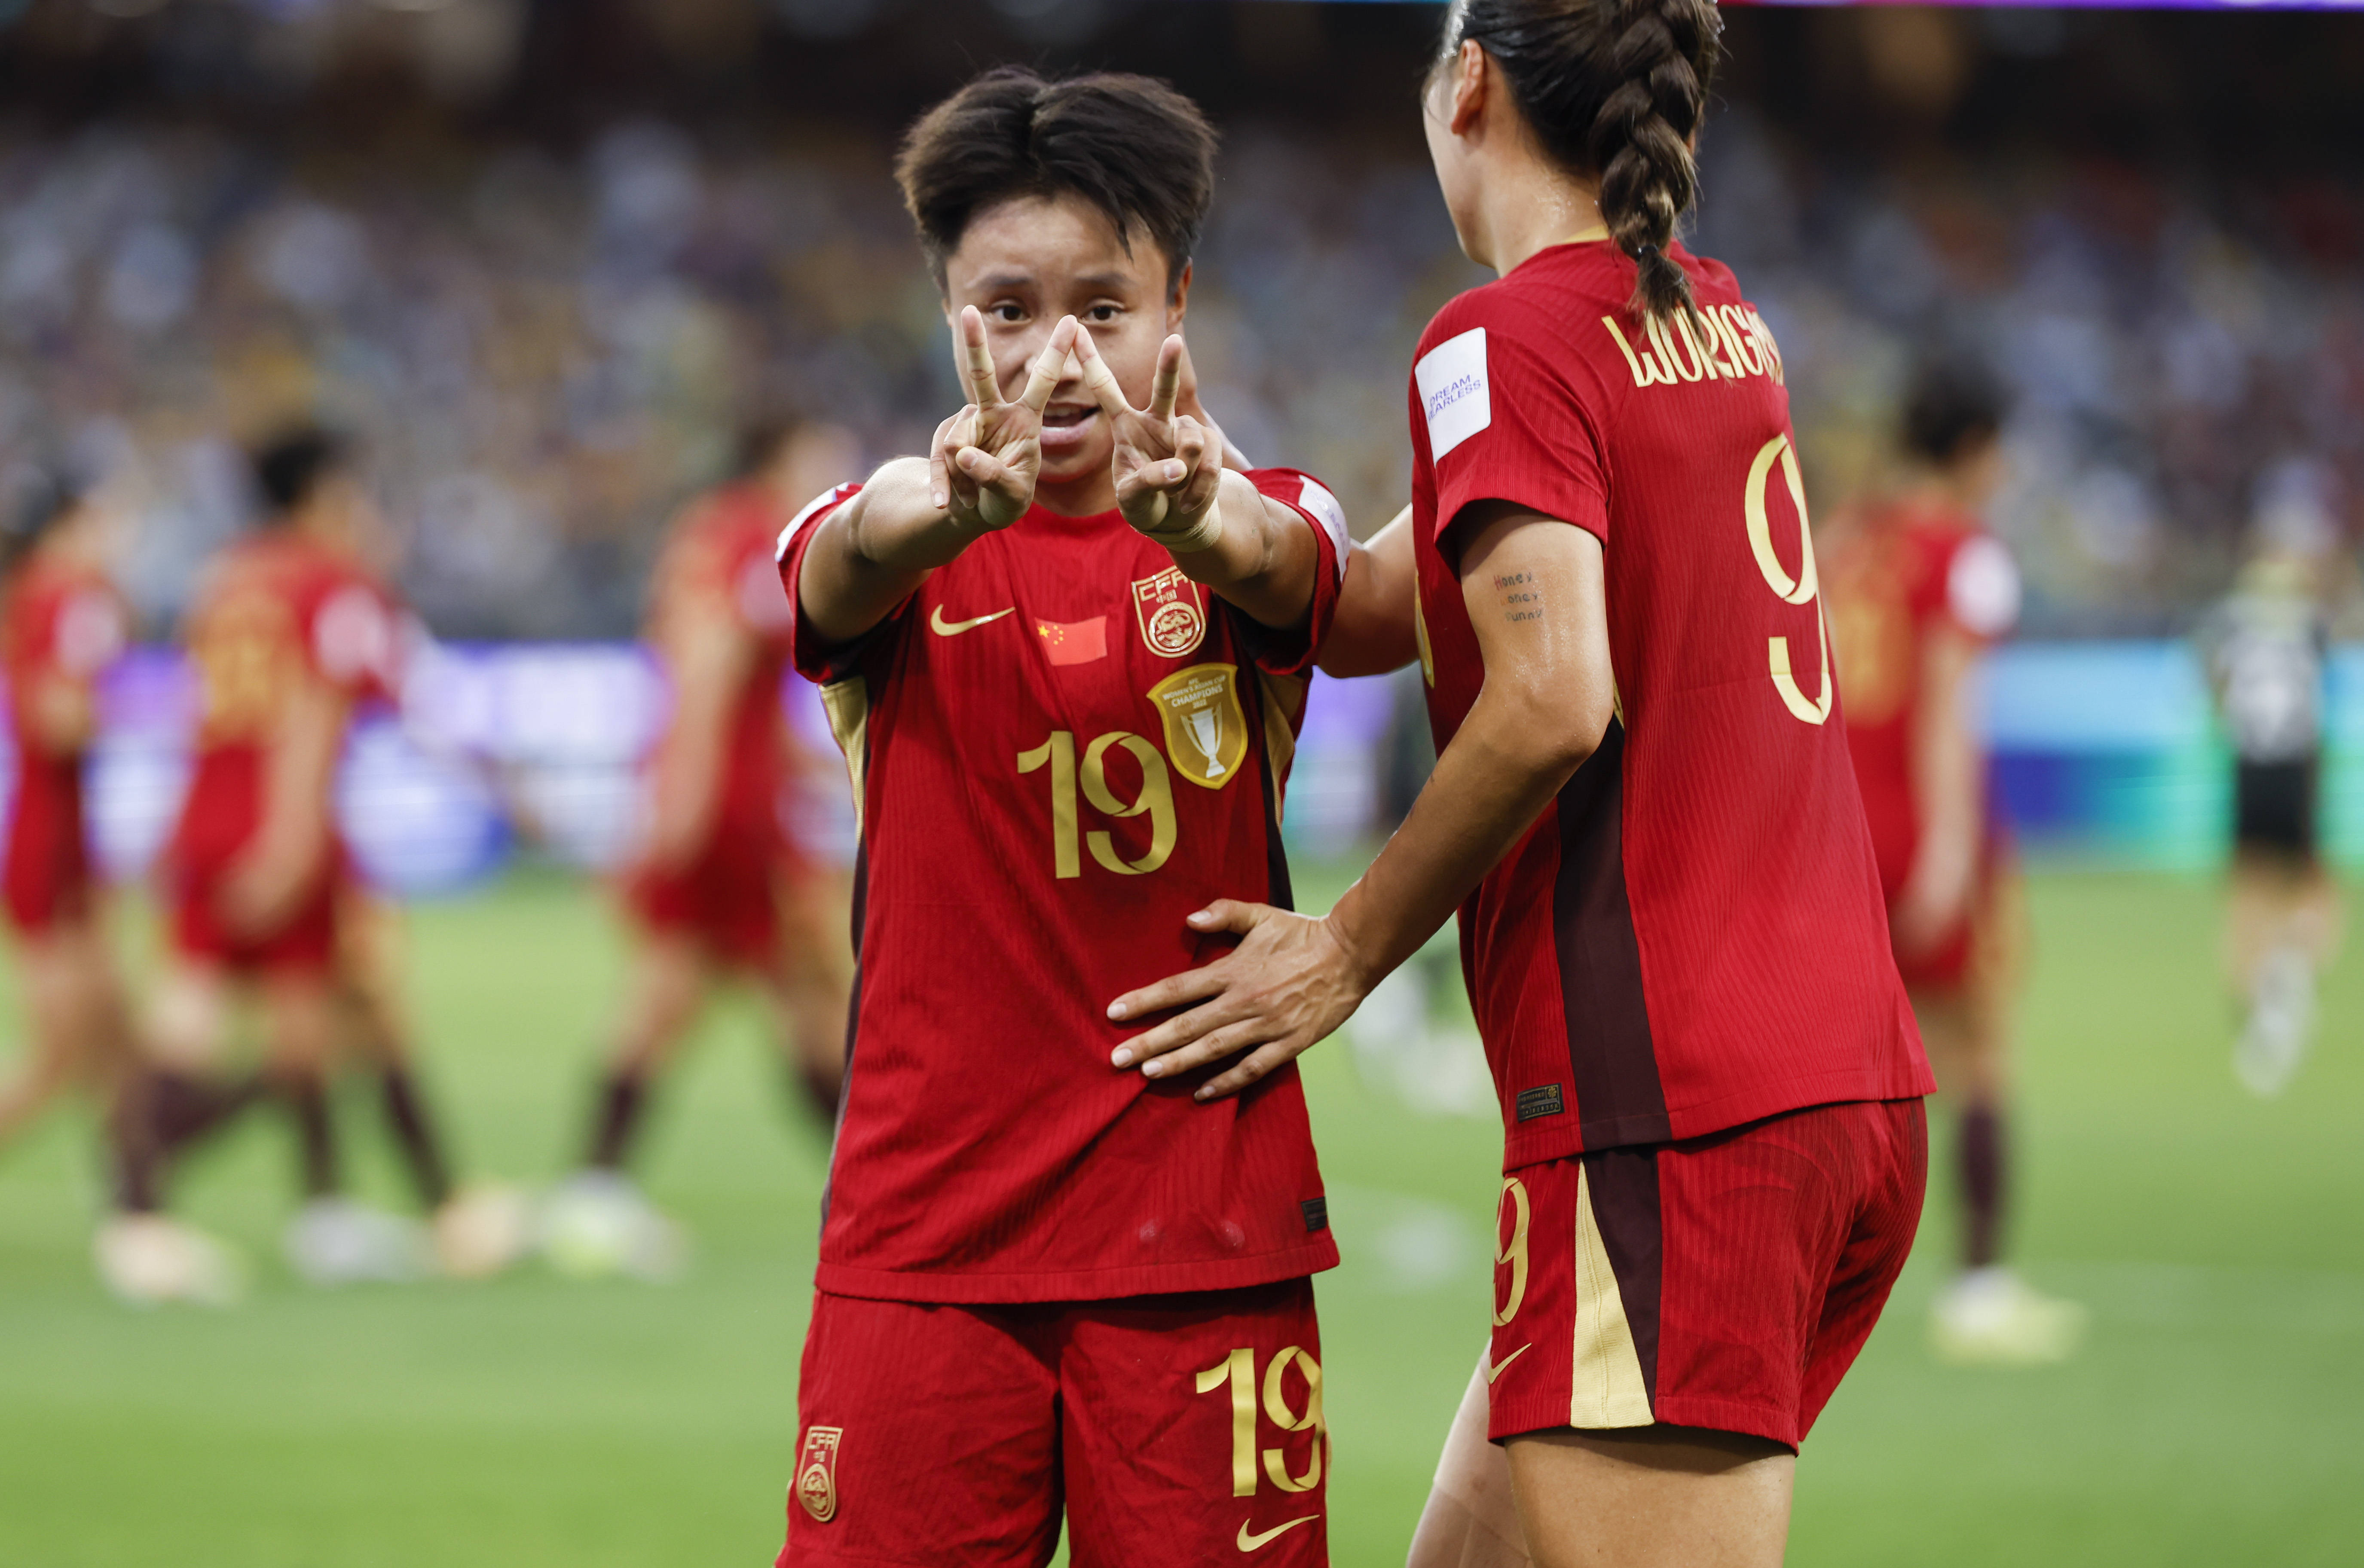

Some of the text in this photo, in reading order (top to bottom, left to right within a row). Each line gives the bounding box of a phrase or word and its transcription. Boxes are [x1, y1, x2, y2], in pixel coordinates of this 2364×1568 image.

[1430, 374, 1470, 408] DREAM
[1139, 569, 1188, 602] CFA
[1494, 572, 1532, 591] Honey
[1745, 432, 1832, 725] 9
[1171, 684, 1223, 707] CHAMPIONS
[1017, 731, 1177, 879] 19
[1493, 1177, 1530, 1327] 9
[1196, 1345, 1326, 1497] 19
[808, 1432, 837, 1450] CFA
